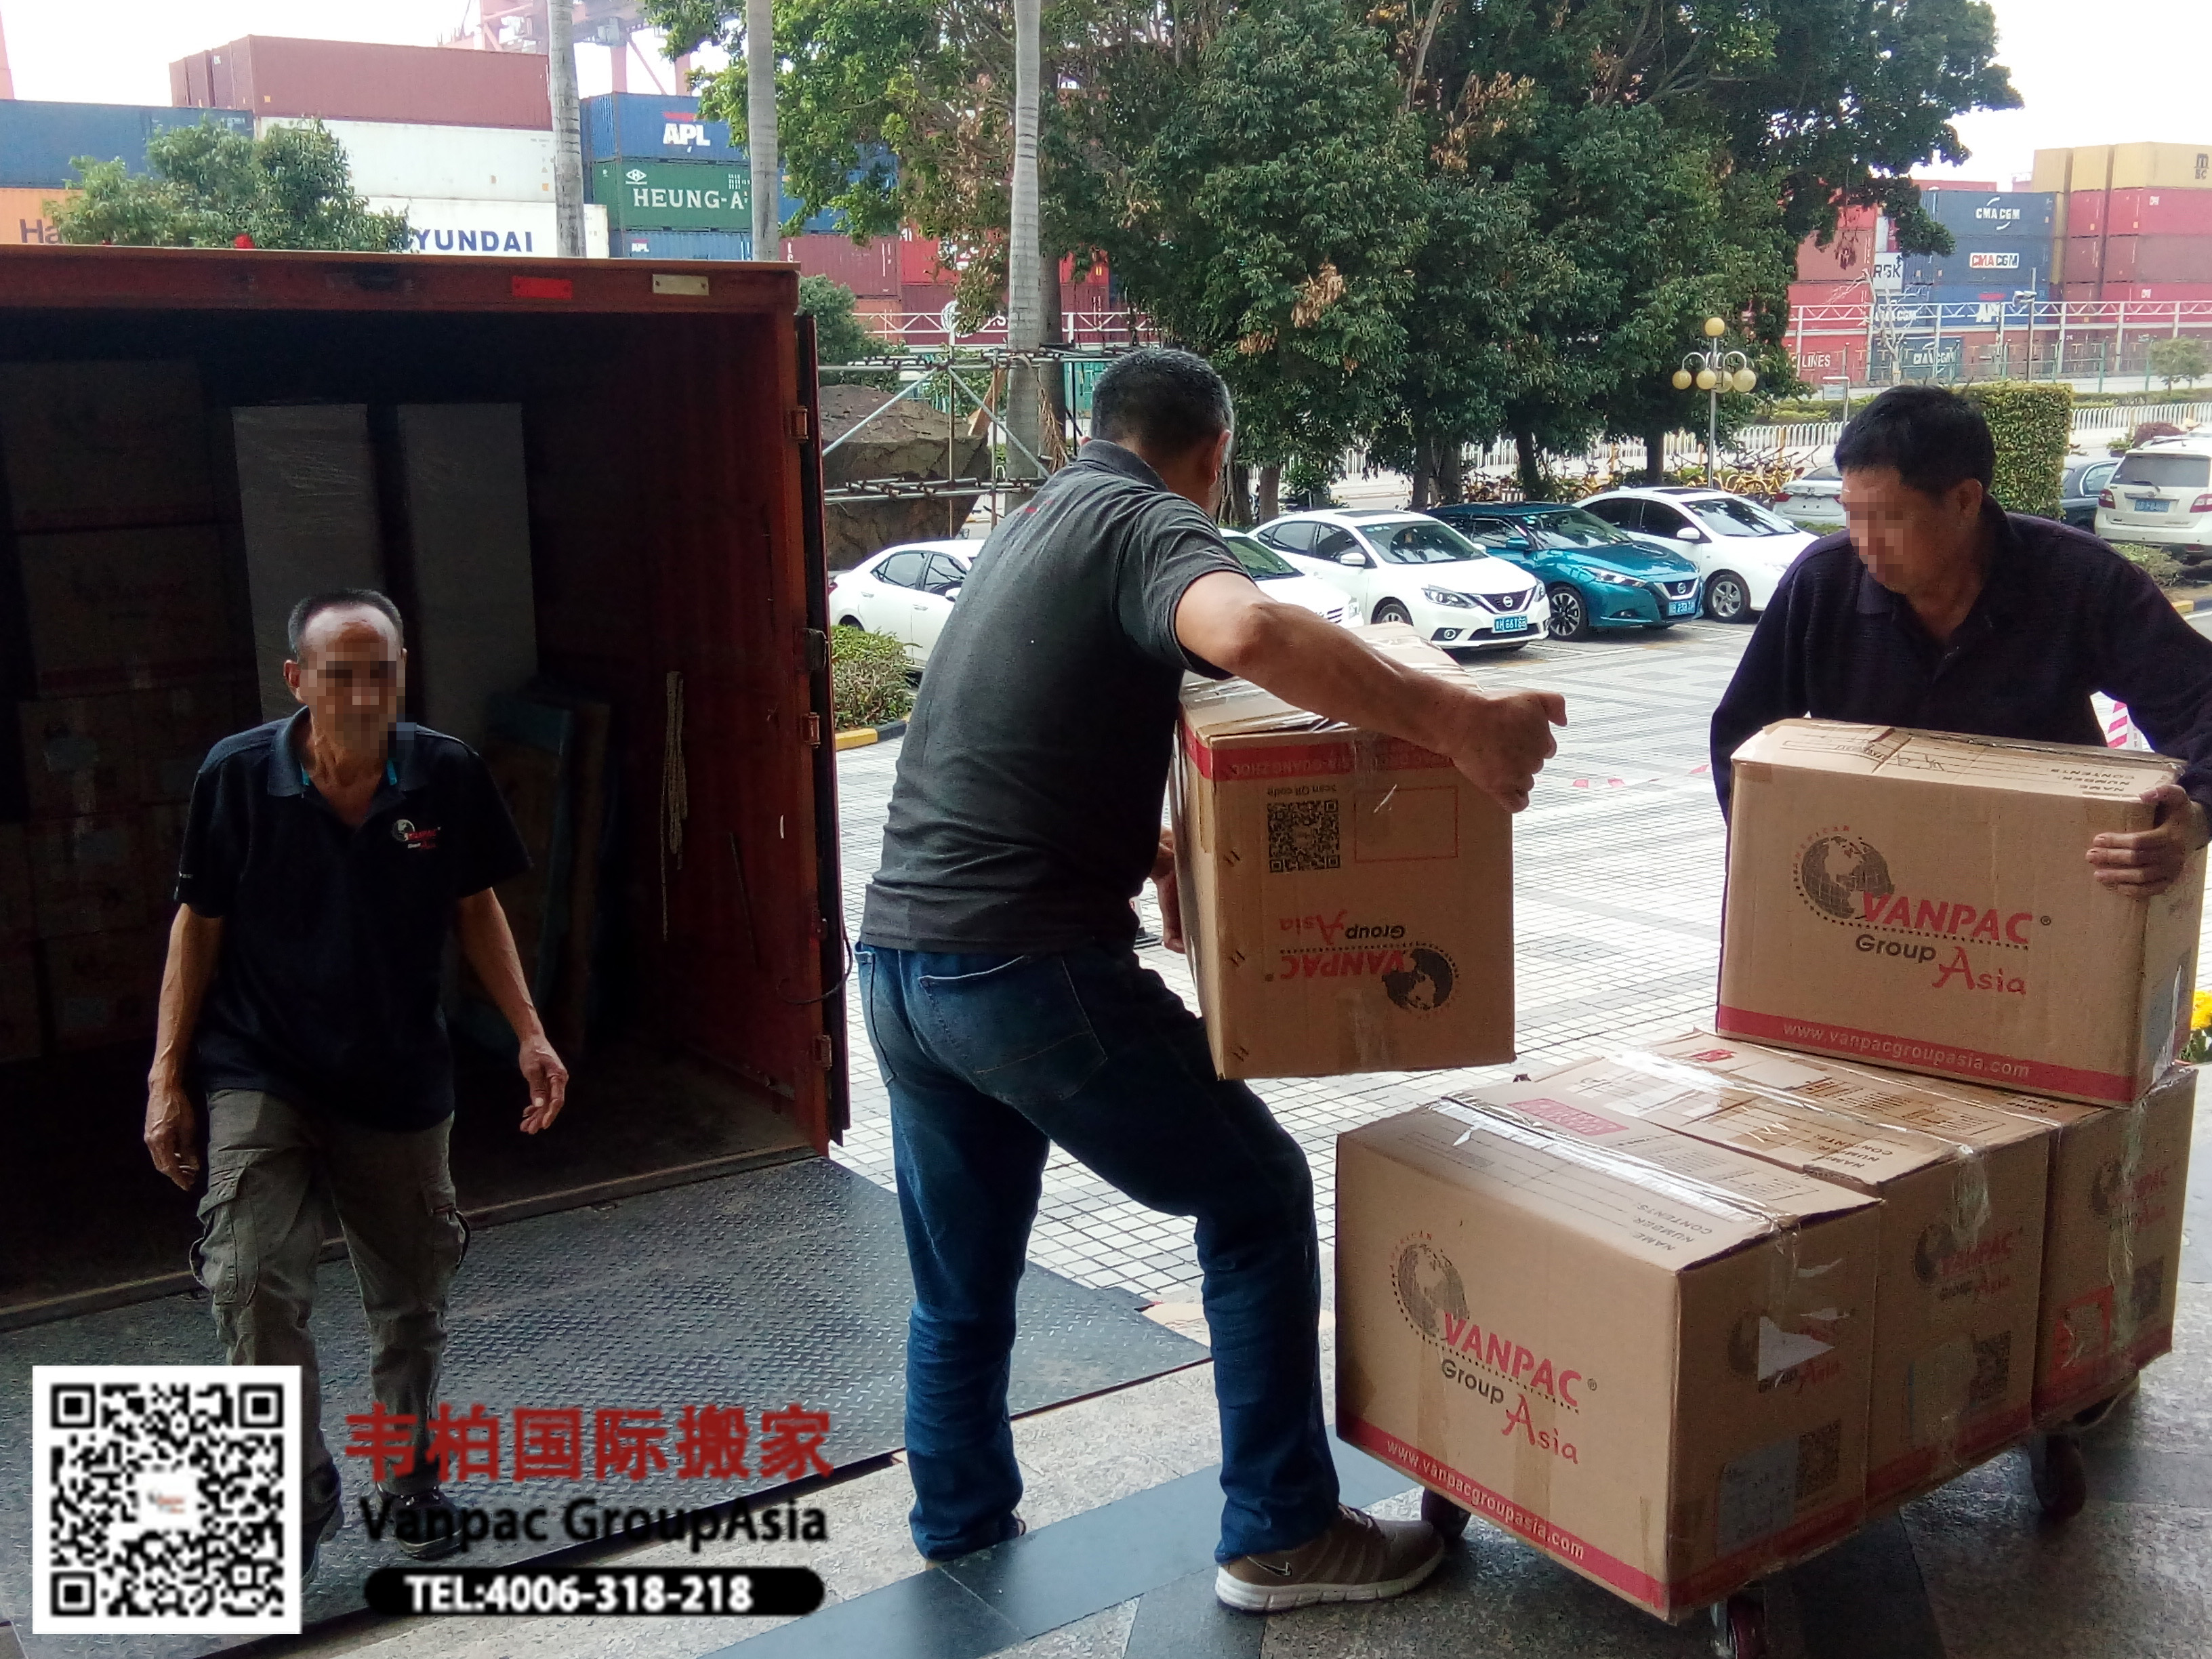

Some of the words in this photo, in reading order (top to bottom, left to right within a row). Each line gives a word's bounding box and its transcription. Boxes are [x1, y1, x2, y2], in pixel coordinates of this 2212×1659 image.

[663, 123, 711, 146] APL
[633, 188, 745, 210] HEUNG-A
[1975, 207, 1998, 220] CMA
[1999, 208, 2020, 220] CGM
[19, 218, 62, 245] Ha
[398, 228, 533, 253] YUNDAI
[631, 242, 649, 253] APL
[1971, 254, 1994, 266] CMA
[1996, 254, 2018, 267] CGM
[1801, 353, 1830, 368] LINES
[1279, 908, 1349, 947] Asia
[1345, 924, 1406, 940] Group
[1861, 892, 2034, 945] VANPAC
[1279, 949, 1406, 980] VANPAC
[1856, 934, 1938, 964] Group
[1931, 945, 2027, 996] Asia
[1783, 1022, 2032, 1079] www.vanpacgroupasia.com
[1443, 1311, 1582, 1408] VANPAC
[1441, 1357, 1504, 1405] Group
[1500, 1392, 1579, 1465] Asia
[1385, 1437, 1585, 1560] www.vanpacgroupasia.com
